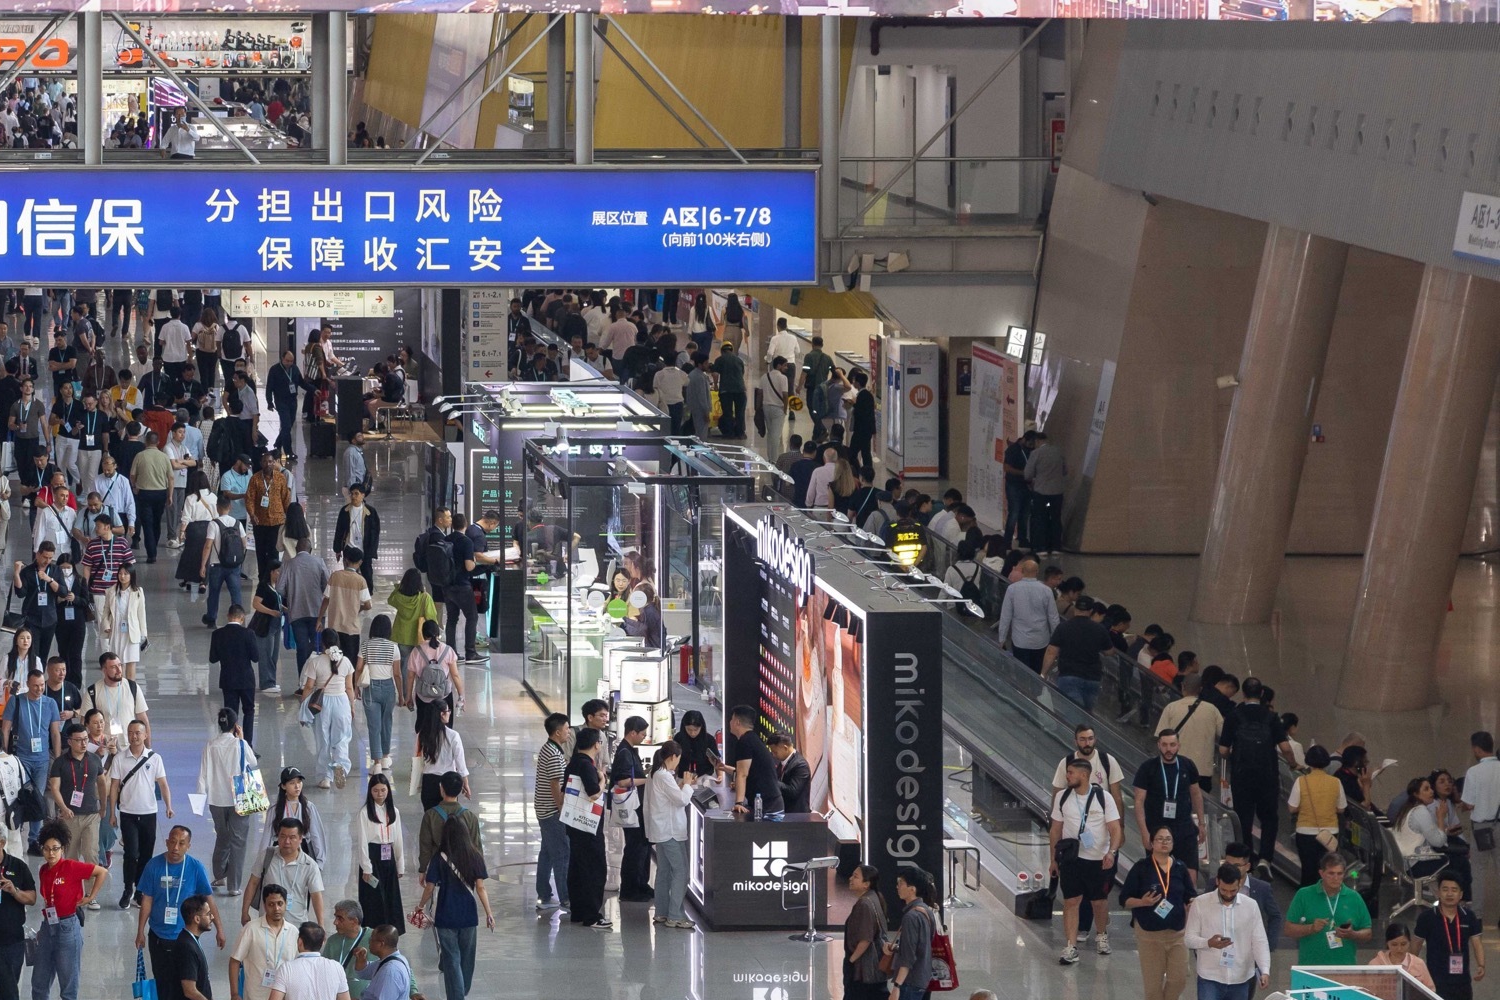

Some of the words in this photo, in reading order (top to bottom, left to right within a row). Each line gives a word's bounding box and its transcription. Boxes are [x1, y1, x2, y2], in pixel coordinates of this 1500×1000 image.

[205, 188, 503, 223] 分担出口风险
[591, 211, 649, 226] 展区位置
[257, 236, 556, 272] 保障收汇安全
[272, 300, 279, 308] A
[318, 300, 326, 308] D
[482, 490, 513, 498] 产品计
[756, 514, 811, 607] mikodesign
[578, 815, 598, 825] KITCHEN
[733, 880, 809, 894] mikodesign
